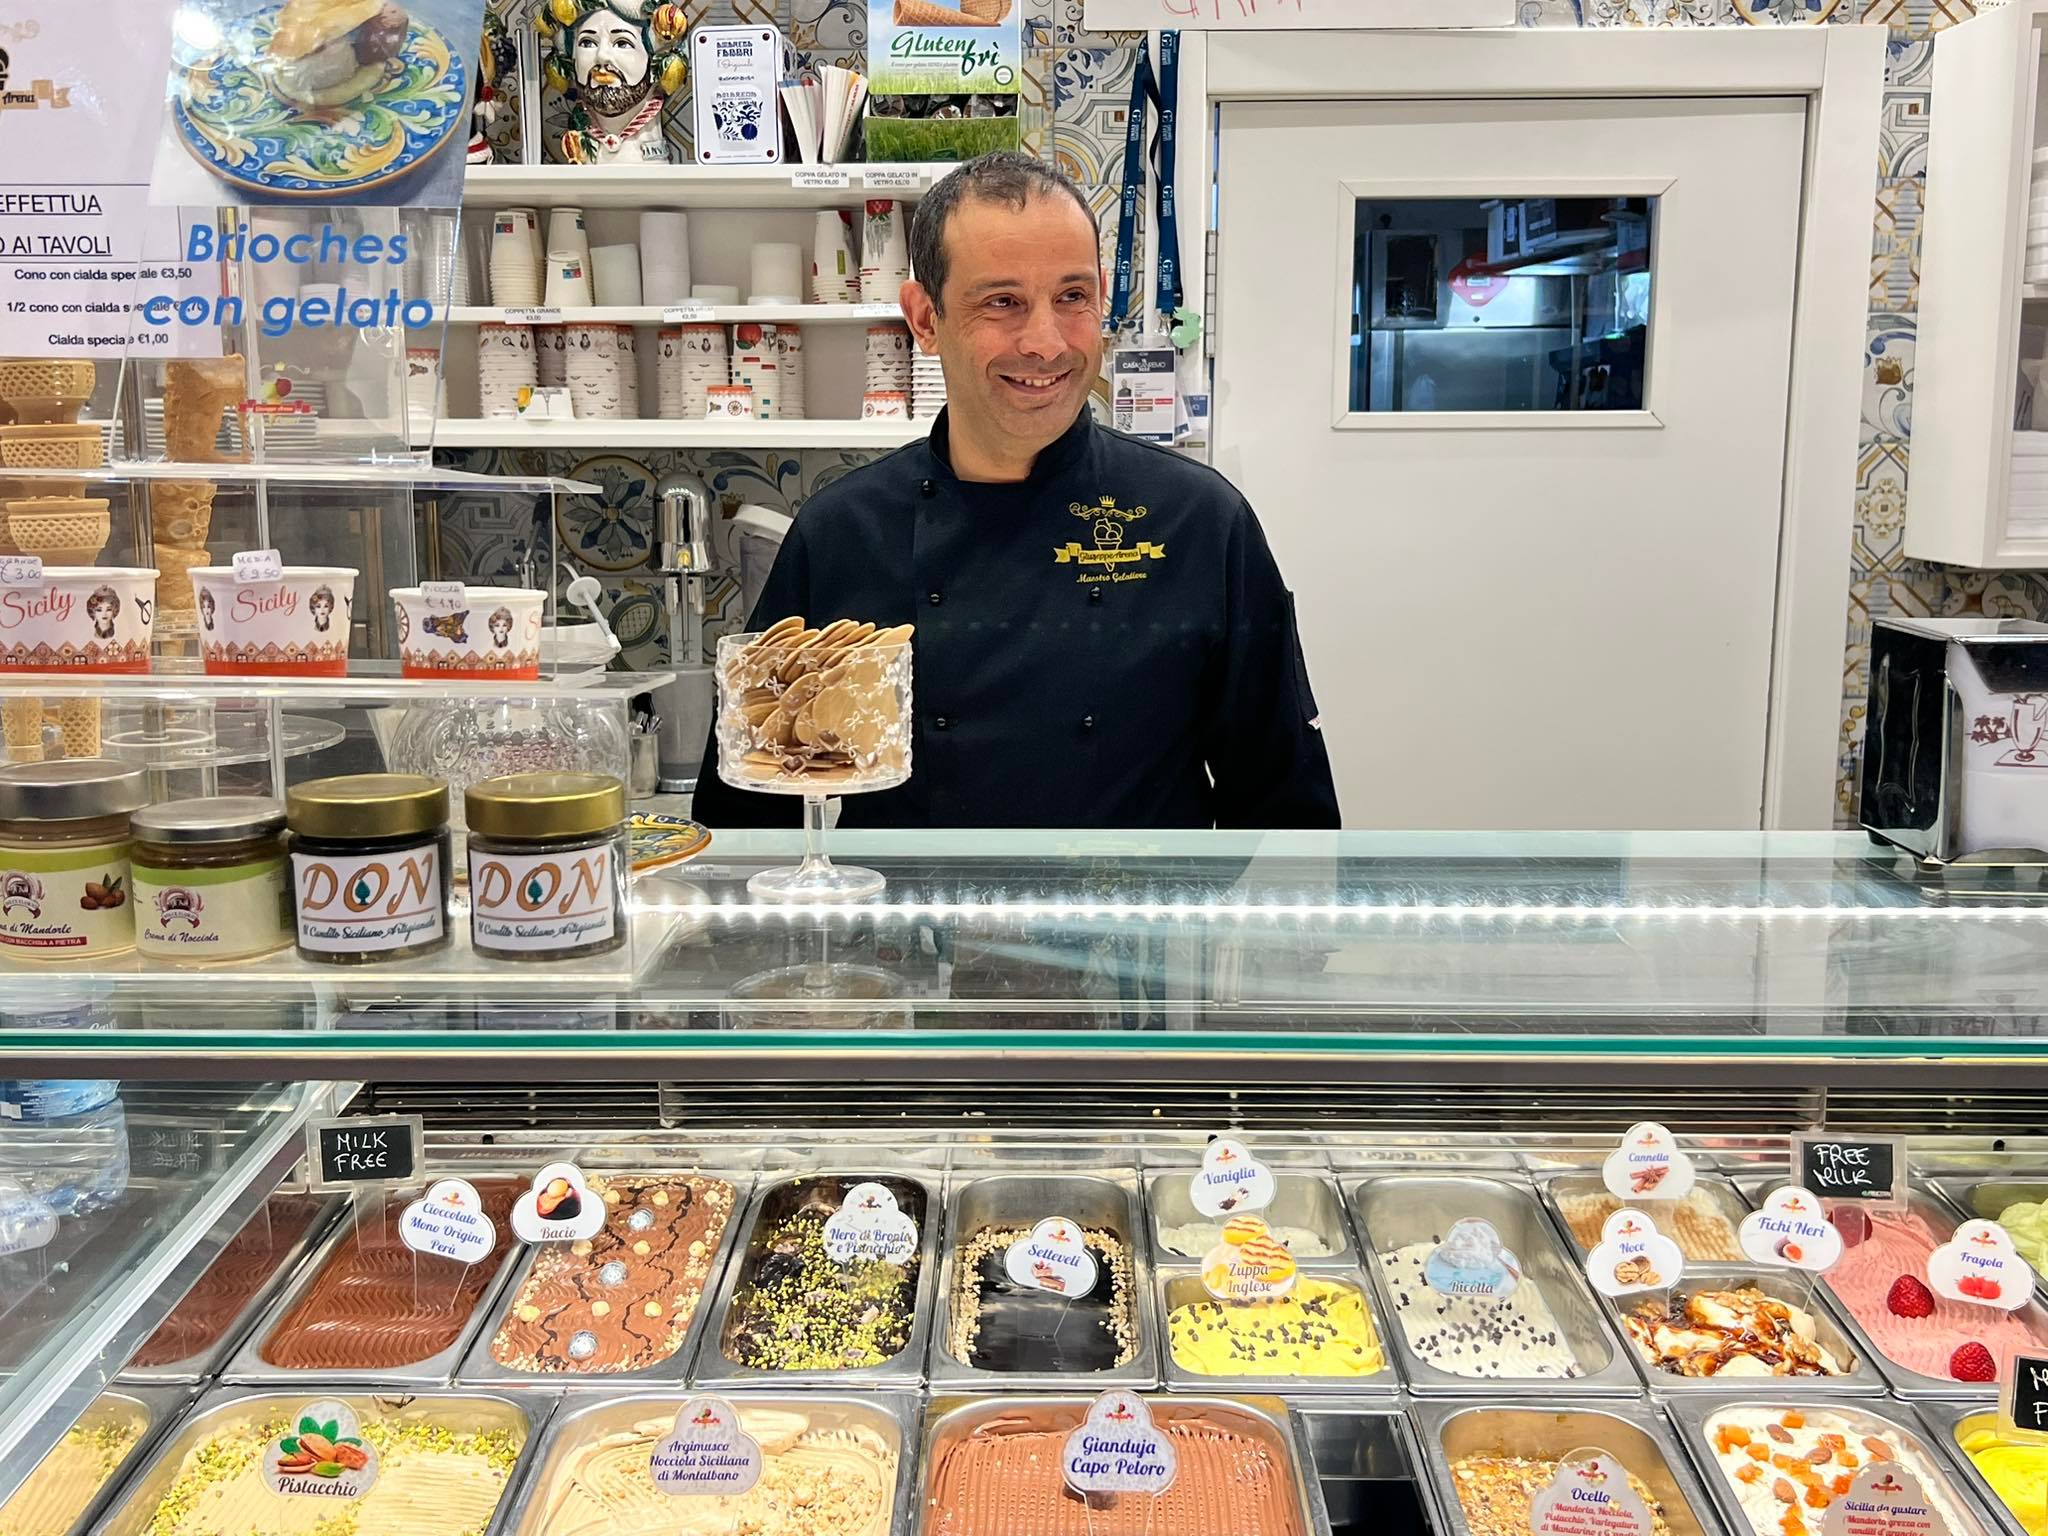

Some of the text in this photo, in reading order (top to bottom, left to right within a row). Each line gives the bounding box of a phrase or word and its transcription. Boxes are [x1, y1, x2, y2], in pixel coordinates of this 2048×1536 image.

[890, 30, 967, 58] Gluten
[0, 194, 103, 213] FFETTUA
[12, 235, 32, 255] AI
[37, 235, 112, 255] TAVOLI
[186, 223, 409, 266] Brioches
[14, 269, 48, 281] Cono
[49, 270, 71, 281] con
[73, 268, 108, 281] cialda
[161, 267, 192, 280] €3,50
[7, 302, 26, 313] 1/2
[29, 303, 59, 314] cono
[62, 303, 83, 313] con
[85, 301, 120, 313] cialda
[142, 287, 434, 338] con gelato
[48, 334, 85, 346] Cialda
[138, 333, 169, 345] €1,00
[0, 586, 77, 629] Sicily
[230, 585, 300, 624] Sicily
[302, 852, 434, 916] DON
[478, 852, 606, 915] DON
[10, 923, 18, 933] di
[20, 922, 73, 935] Mandorle
[144, 928, 220, 943] Crema di Nocciola
[342, 926, 384, 940] Siciliano
[515, 924, 556, 938] Siciliano
[336, 1131, 388, 1152] MILK
[333, 1151, 388, 1173] FREE
[1628, 1152, 1669, 1163] Cannella
[1812, 1143, 1871, 1169] FREE
[1203, 1166, 1256, 1187] Vaniglia
[422, 1202, 478, 1226] Cioccolato
[411, 1216, 485, 1246] Mono Origine
[540, 1227, 577, 1240] Bacio
[829, 1228, 856, 1241] Nero
[859, 1229, 871, 1241] di
[1758, 1216, 1826, 1239] Fichi Neri
[430, 1239, 456, 1256] Perù
[845, 1243, 905, 1255] Pistacchio
[1027, 1243, 1082, 1268] Setteveli
[1619, 1242, 1645, 1254] Noce
[1959, 1251, 2004, 1269] Fragola
[1227, 1262, 1269, 1287] Zuppa
[1226, 1278, 1273, 1293] Inglese
[1450, 1280, 1494, 1294] Ricotta
[668, 1440, 731, 1455] Argimusco
[1082, 1436, 1157, 1459] Gianduja
[649, 1455, 750, 1467] Nocciola Siciliana
[1071, 1457, 1166, 1478] Capo Peloro
[657, 1470, 740, 1481] di Montalbano
[278, 1475, 359, 1497] Pistacchio
[1570, 1487, 1612, 1503] Ocello
[1844, 1501, 1928, 1516] Sicilia da gustare
[1540, 1522, 1549, 1532] di
[1550, 1523, 1597, 1536] Mandarino
[1847, 1526, 1876, 1536] canditi
[1887, 1519, 1916, 1529] grezza
[1916, 1521, 1931, 1529] con
